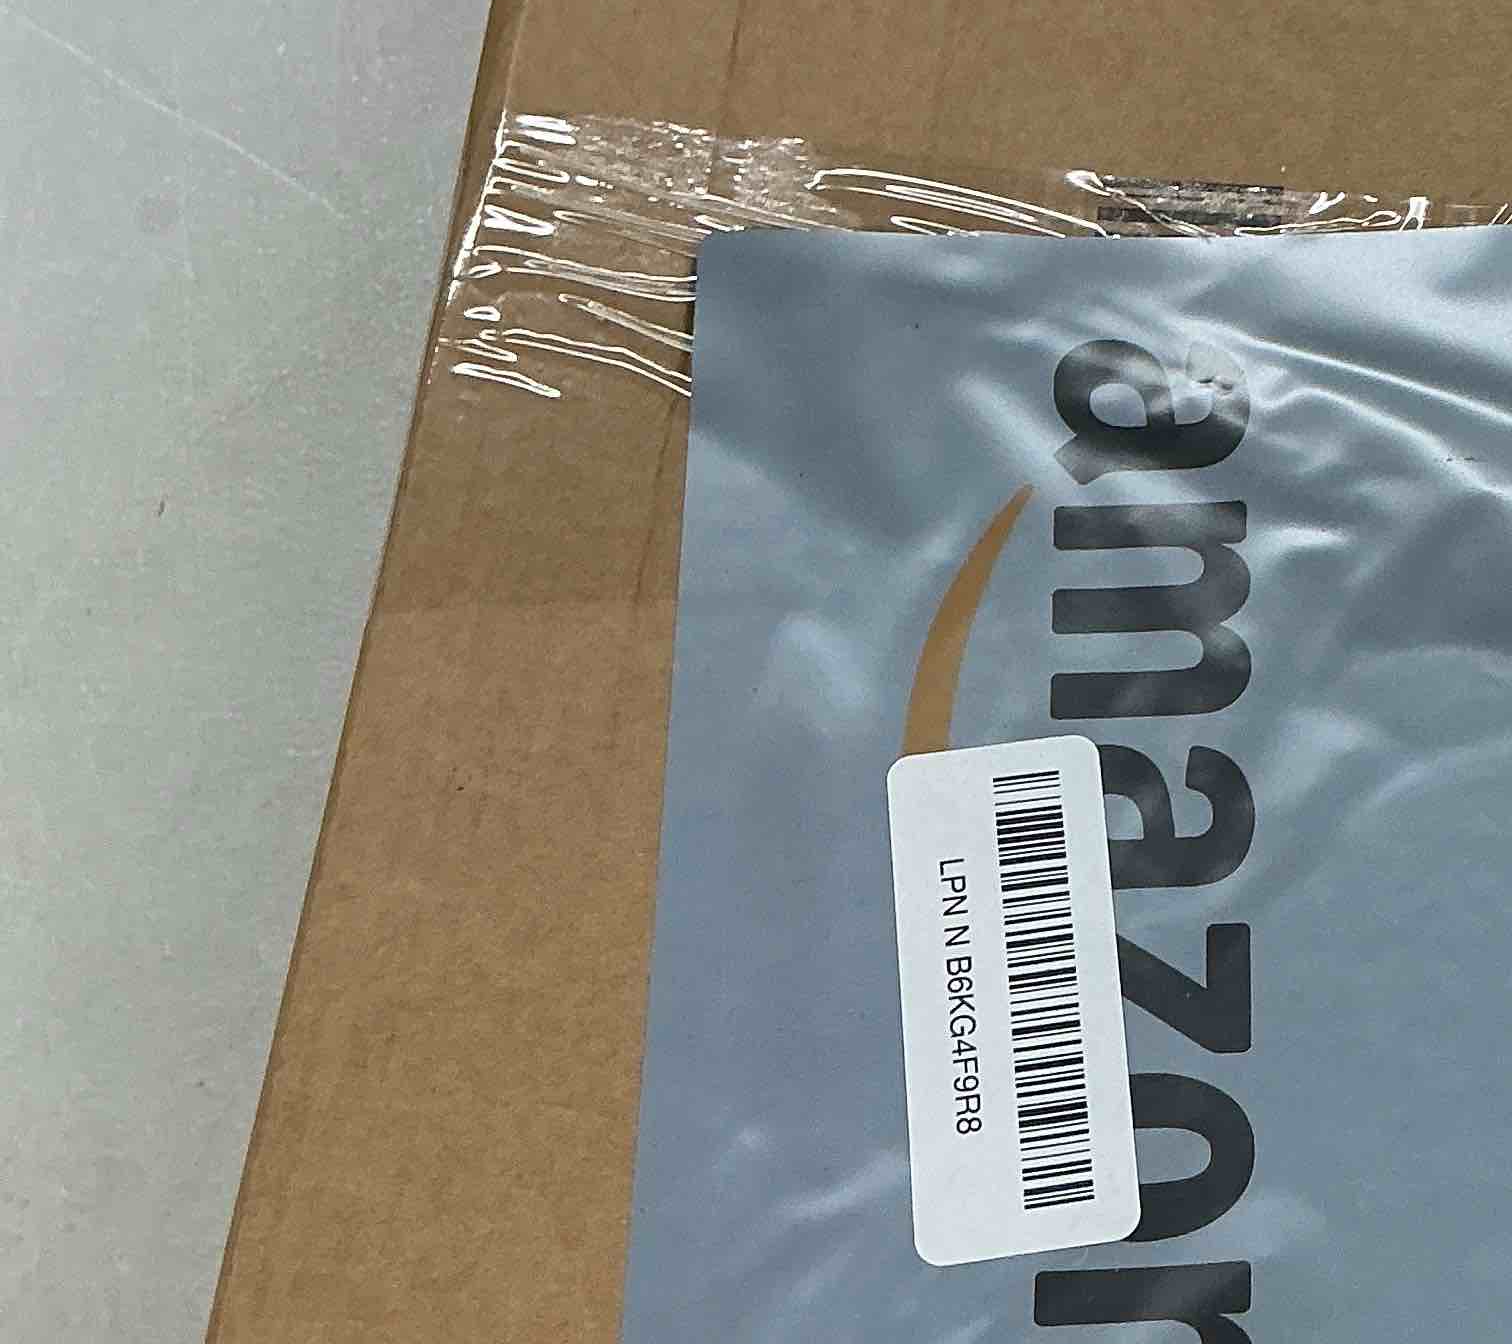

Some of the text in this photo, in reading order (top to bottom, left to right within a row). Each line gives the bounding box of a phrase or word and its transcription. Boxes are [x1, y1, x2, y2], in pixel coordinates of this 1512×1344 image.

[938, 857, 982, 1135] LPN N B6KG4F9R8
